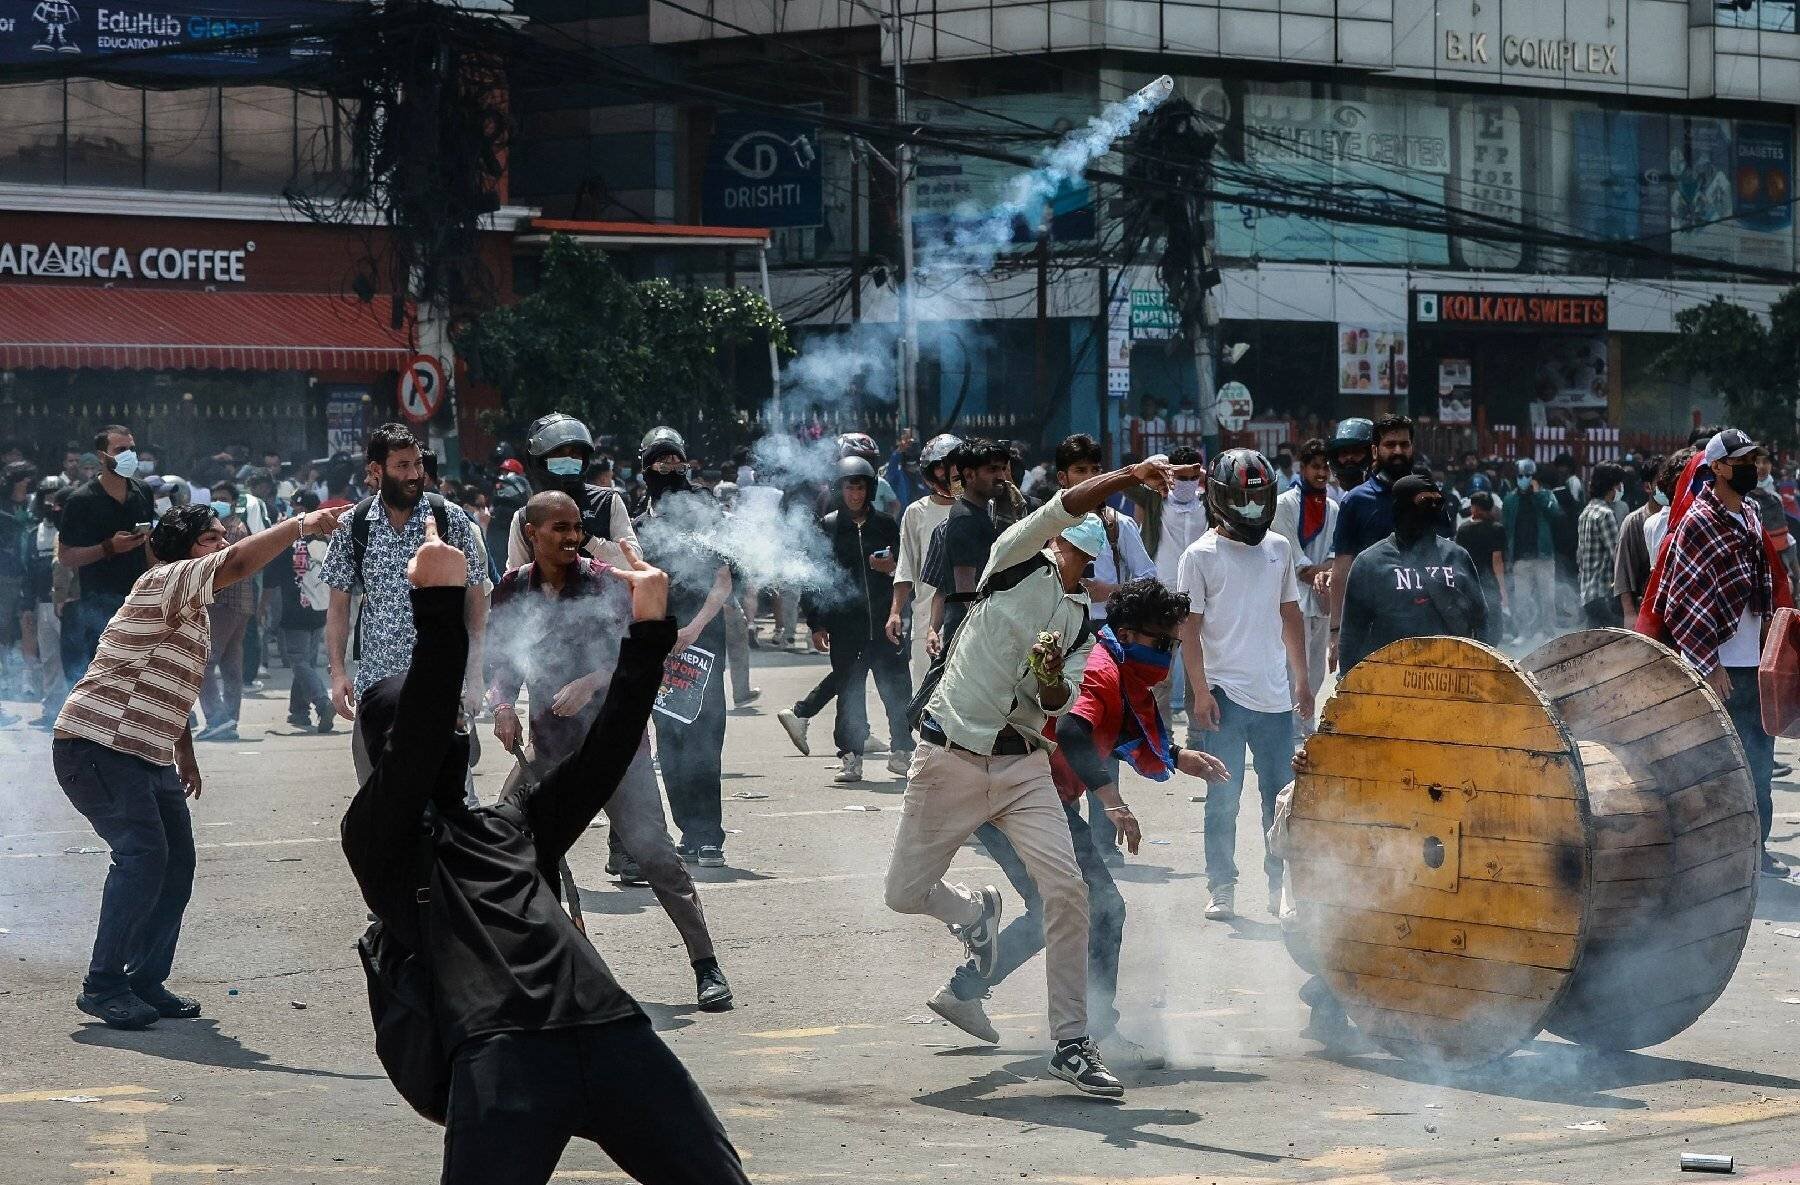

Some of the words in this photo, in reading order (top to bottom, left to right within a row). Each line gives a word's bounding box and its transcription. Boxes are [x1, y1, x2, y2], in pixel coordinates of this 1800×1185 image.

[98, 9, 181, 36] EduHub
[98, 37, 158, 50] EDUCATION
[1446, 30, 1487, 64] B.K
[1503, 34, 1617, 75] COMPLEX
[1321, 129, 1361, 161] EYE
[1367, 134, 1447, 167] CENTER
[724, 184, 801, 208] DRISHTI
[0, 242, 133, 279] ARABICA
[140, 248, 246, 281] COFFEE
[1442, 296, 1527, 322] KOLKATA
[1529, 297, 1605, 325] SWEETS
[680, 652, 708, 671] NEPAL
